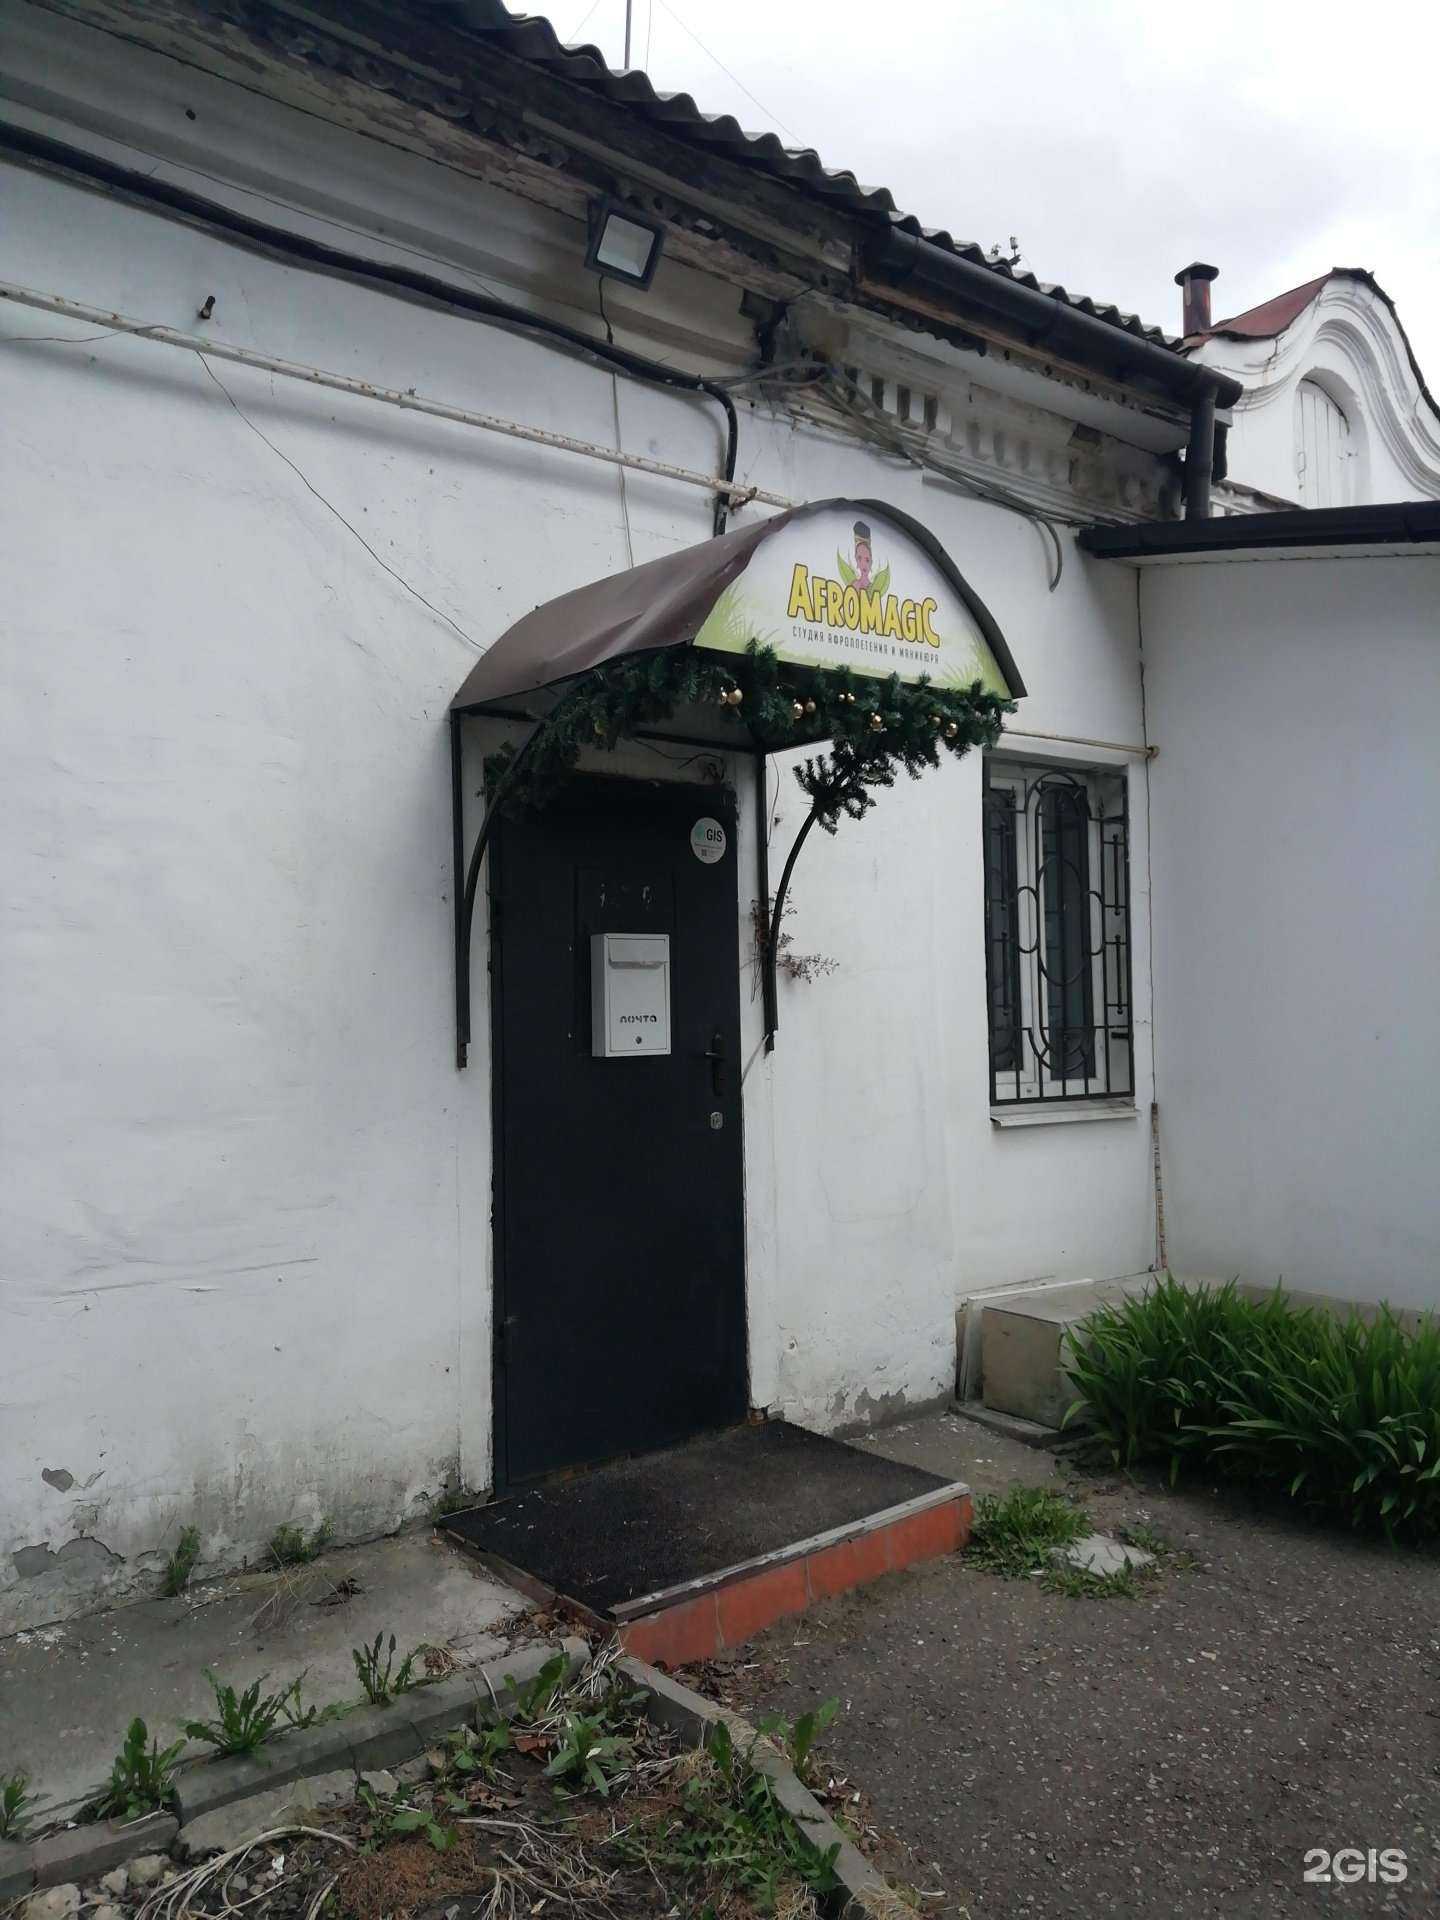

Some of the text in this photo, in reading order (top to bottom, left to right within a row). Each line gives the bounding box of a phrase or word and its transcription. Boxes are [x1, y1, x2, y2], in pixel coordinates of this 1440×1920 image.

[792, 626, 824, 642] СТУДИЯ
[828, 634, 888, 655] АФРОПЛЕТЕНИЯ
[899, 649, 939, 664] МАНИКЮРА
